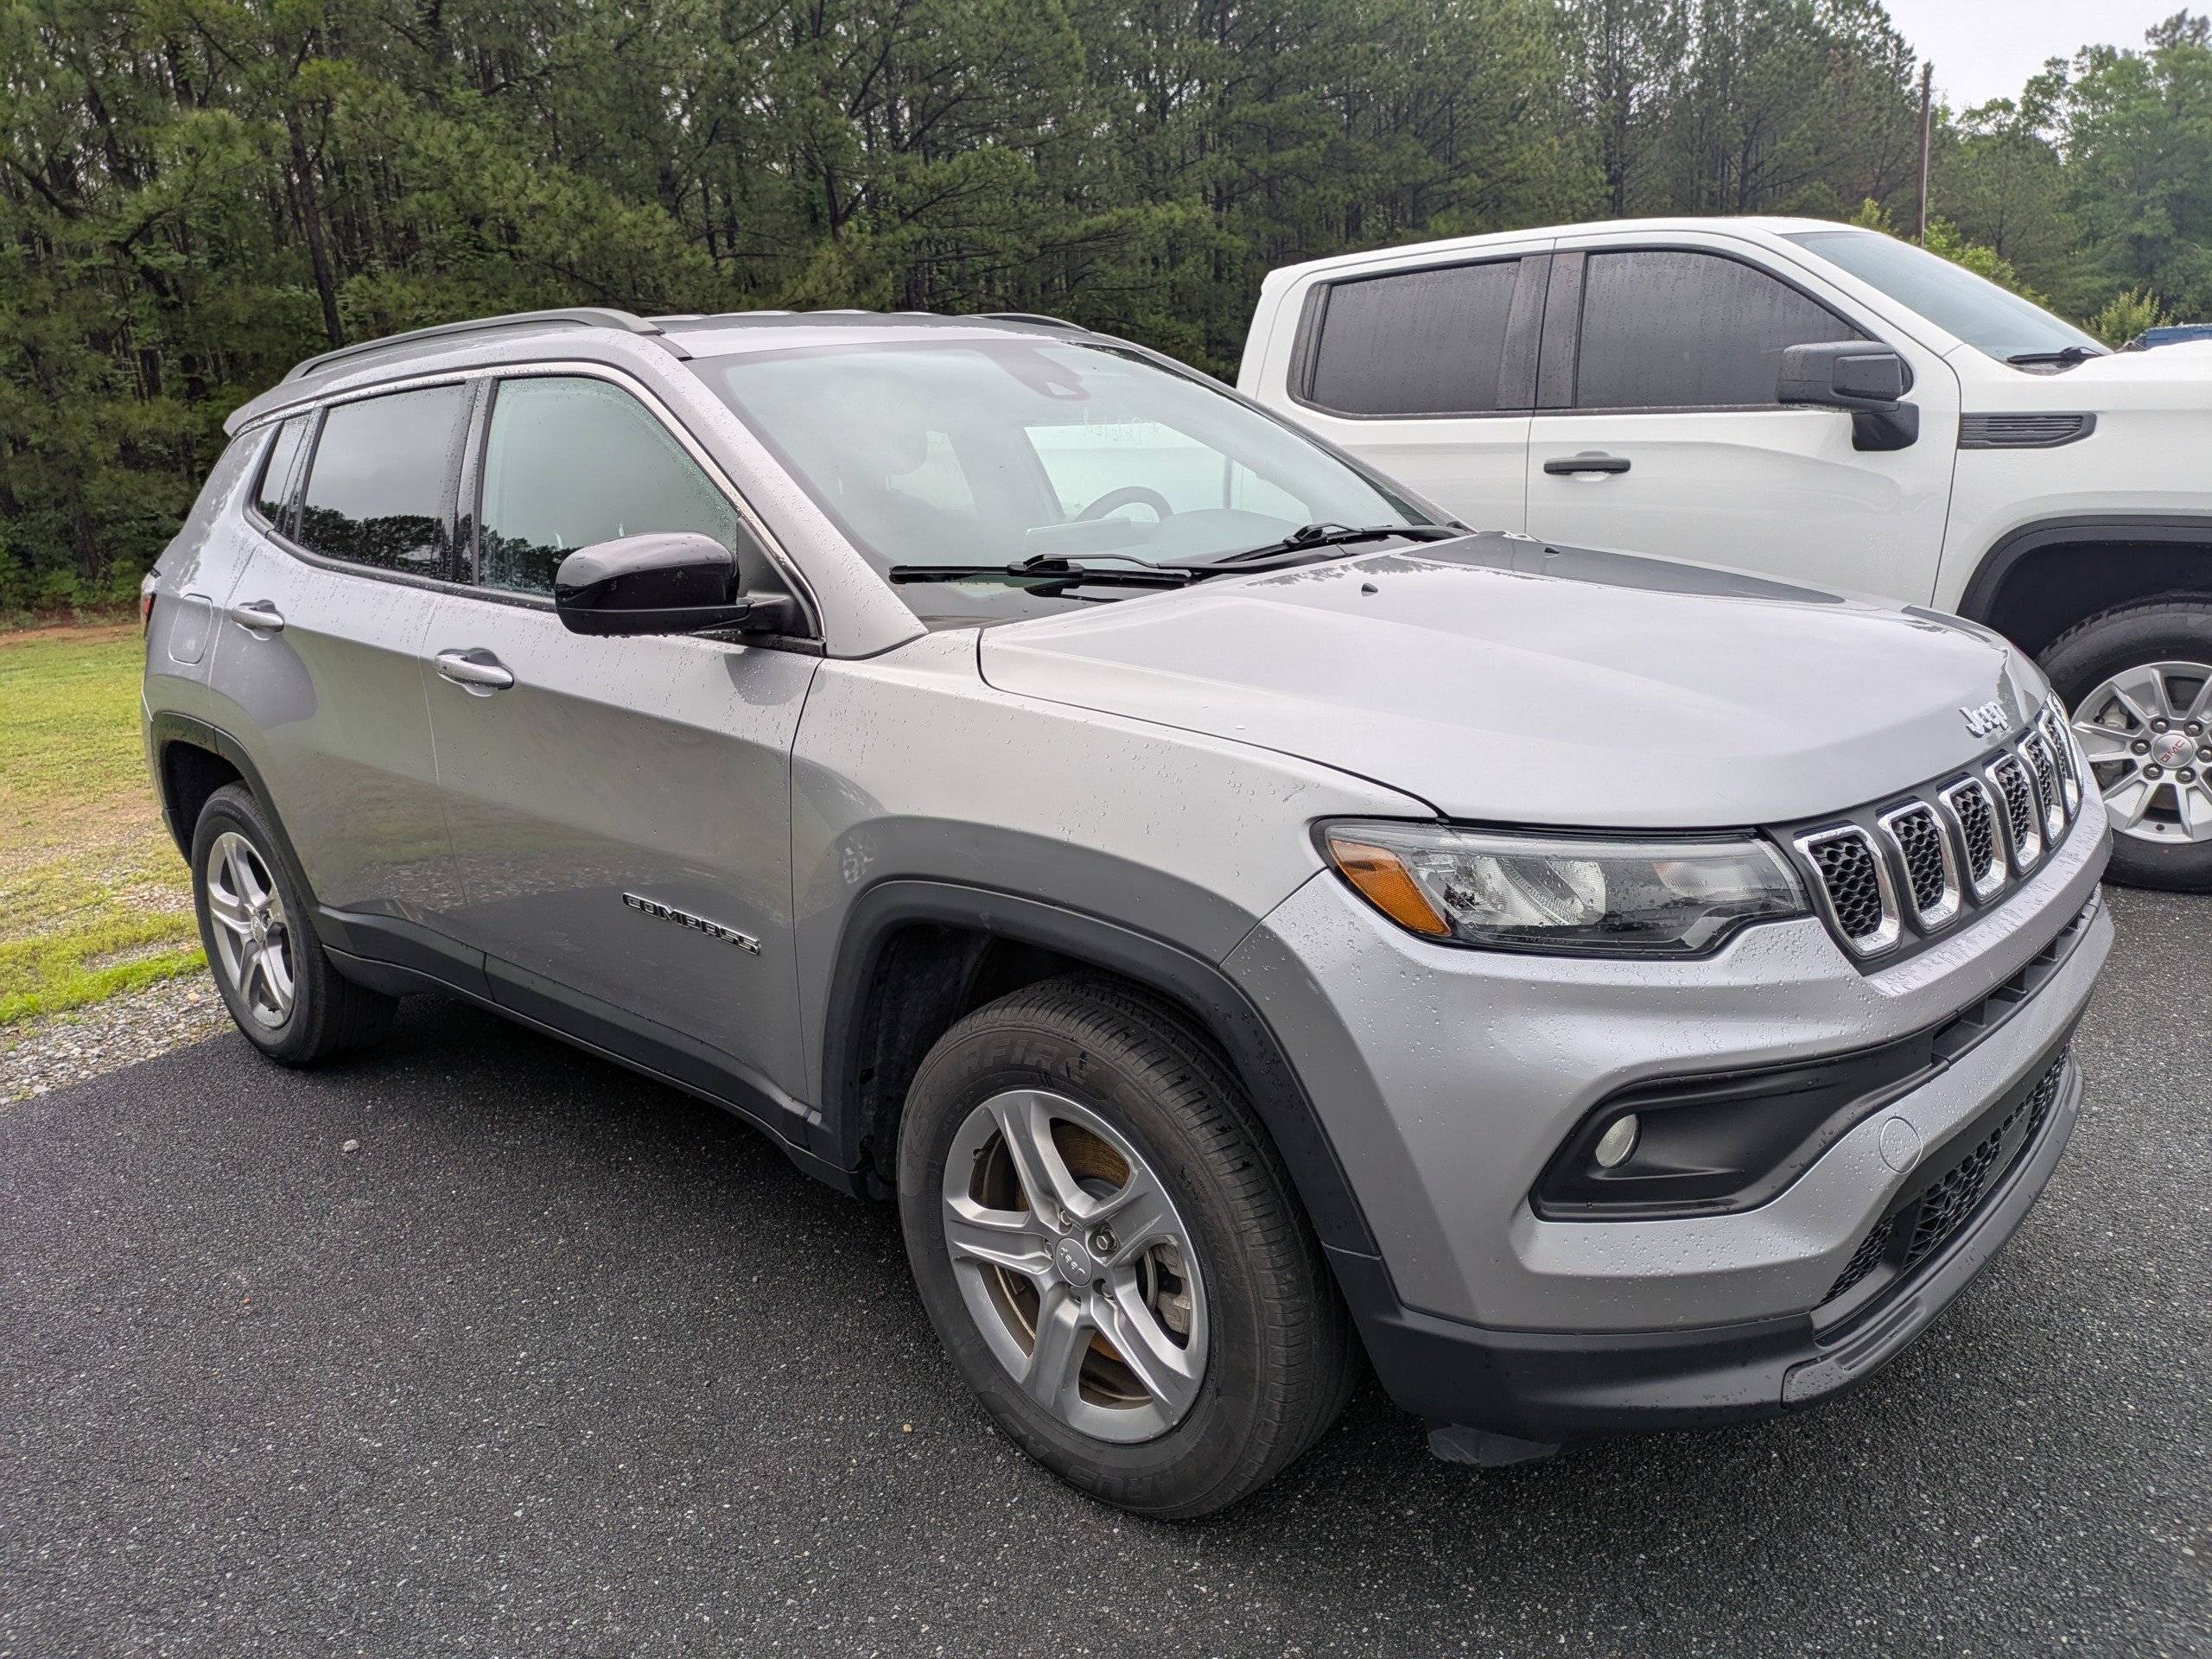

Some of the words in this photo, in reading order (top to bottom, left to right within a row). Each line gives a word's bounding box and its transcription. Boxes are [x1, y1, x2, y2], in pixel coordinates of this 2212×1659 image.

[1958, 702, 2008, 738] Jeep
[2160, 739, 2185, 763] GMC
[621, 892, 761, 955] COMPASS
